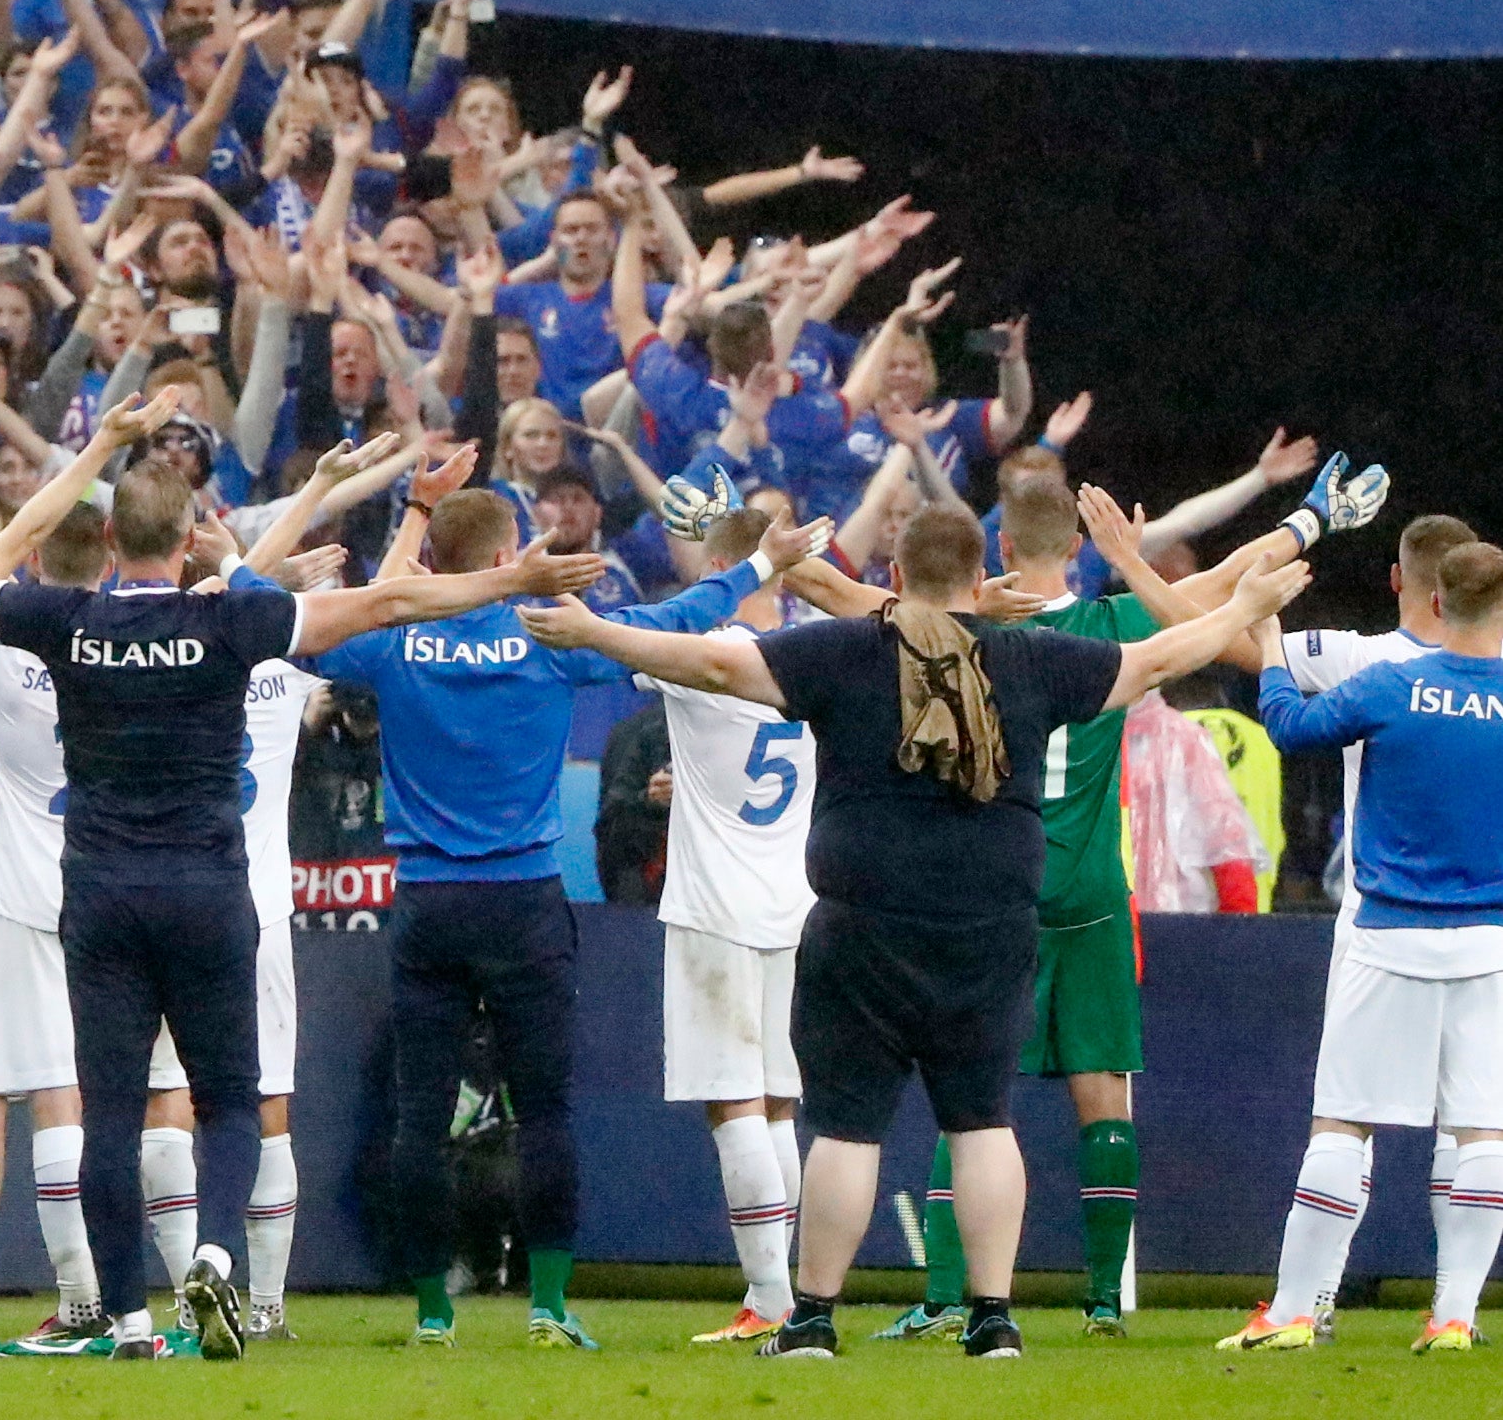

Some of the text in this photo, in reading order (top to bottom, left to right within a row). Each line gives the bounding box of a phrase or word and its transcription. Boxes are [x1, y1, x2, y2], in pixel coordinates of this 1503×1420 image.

[69, 627, 205, 668] ÍSLAND
[402, 626, 529, 665] ÍSLAND
[1409, 677, 1503, 720] ÍSLAN
[737, 720, 805, 827] 5
[291, 862, 397, 905] PHOT
